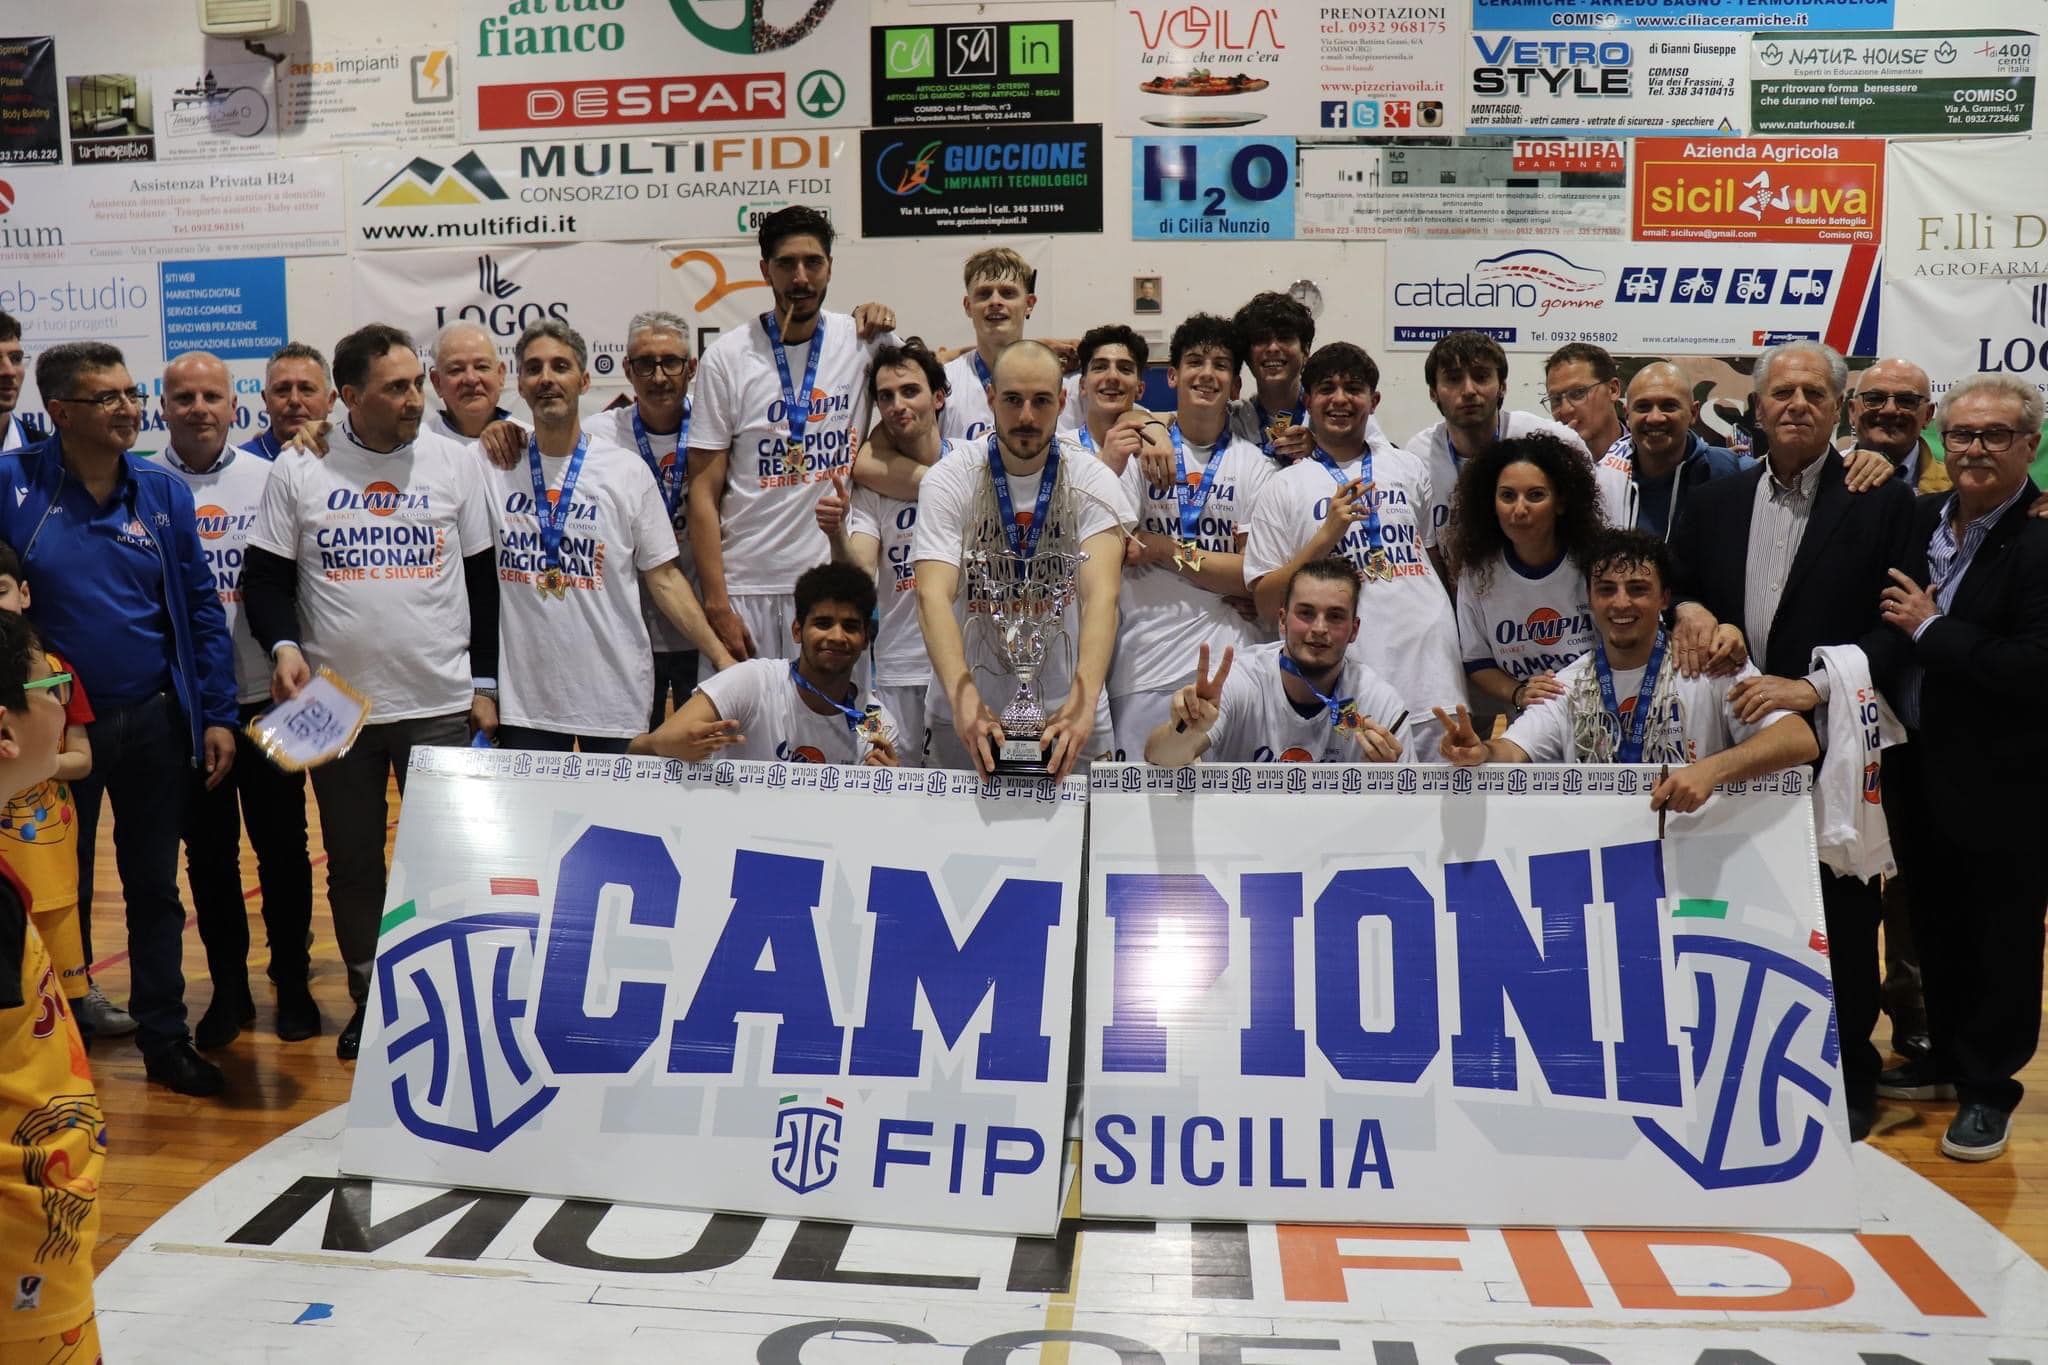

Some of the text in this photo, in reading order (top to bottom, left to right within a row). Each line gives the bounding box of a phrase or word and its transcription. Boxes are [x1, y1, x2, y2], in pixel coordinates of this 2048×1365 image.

[1320, 7, 1446, 20] PRENOTAZIONI
[1636, 13, 1808, 27] www.ciliaceramiche.it
[1320, 21, 1447, 34] tel. 0932 968175
[477, 15, 625, 57] fianco
[1472, 35, 1632, 66] VETRO
[1649, 44, 1737, 56] di Gianni Giuseppe
[1788, 47, 1929, 65] NATUR HOUSE
[1998, 44, 2031, 57] 400
[1193, 51, 1280, 63] che non c'era
[1998, 57, 2031, 66] centri
[1648, 67, 1689, 77] COMISO
[1793, 68, 1822, 77] Esperti
[1833, 67, 1879, 76] Educazione
[1880, 66, 1924, 76] Alimentare
[2007, 65, 2030, 73] italia
[1320, 80, 1445, 95] www.pizzeriavoila.it
[1472, 67, 1631, 95] STYLE
[1648, 78, 1735, 89] Via dei Frassini, 3
[1648, 86, 1735, 97] Tel. 338 3410415
[1760, 83, 1918, 94] Per ritrovare forma benessere
[526, 79, 783, 121] DESPAR
[1760, 95, 1876, 107] che durano nel tempo.
[1952, 88, 2018, 104] COMISO
[1470, 104, 1523, 115] MONTAGGIO:
[1944, 104, 2025, 115] Via A. Gramsci, 17
[1470, 115, 1715, 127] vetri sabbiati vetri camera vetrate di sicurezza specchiere
[1759, 119, 1856, 131] www.naturhouse.it
[1947, 114, 2020, 124] Tel. 0932.723466
[1516, 141, 1621, 158] TOSHIBA
[1683, 143, 1839, 163] Azienda Agricola
[519, 135, 831, 178] MULTIFIDI
[944, 141, 1088, 173] GUCCIONE
[1518, 160, 1618, 169] PARTNER
[129, 172, 295, 193] Assistenza Privata H24
[944, 174, 1088, 190] IMPIANTI TECNOLOGICI
[519, 178, 833, 204] CONSORZIO DI GARANZIA FIDI
[361, 215, 577, 241] www.multifidi.it
[1159, 218, 1270, 233] di Cilia Nunzio
[1785, 216, 1867, 228] di Rosario Battaglia
[1642, 228, 1757, 240] email: siciluva@gmail.com
[1818, 230, 1873, 241] Comiso (RG)
[166, 287, 241, 300] MARKETING DIGITALE
[1394, 273, 1537, 308] catalano
[1538, 298, 1605, 317] gomme
[1400, 329, 1417, 339] Via
[1418, 329, 1444, 341] degli
[1530, 331, 1619, 343] Tel. 0932 965802
[1641, 335, 1736, 346] www.catalanogomme.com
[1978, 337, 2048, 373] LO
[327, 488, 430, 511] OLYMPIA
[316, 526, 435, 549] CAMPIONI
[321, 547, 436, 570] REGIONALI
[324, 566, 435, 582] SERIE C SILVER
[872, 1113, 1396, 1197] FIP SICILIA
